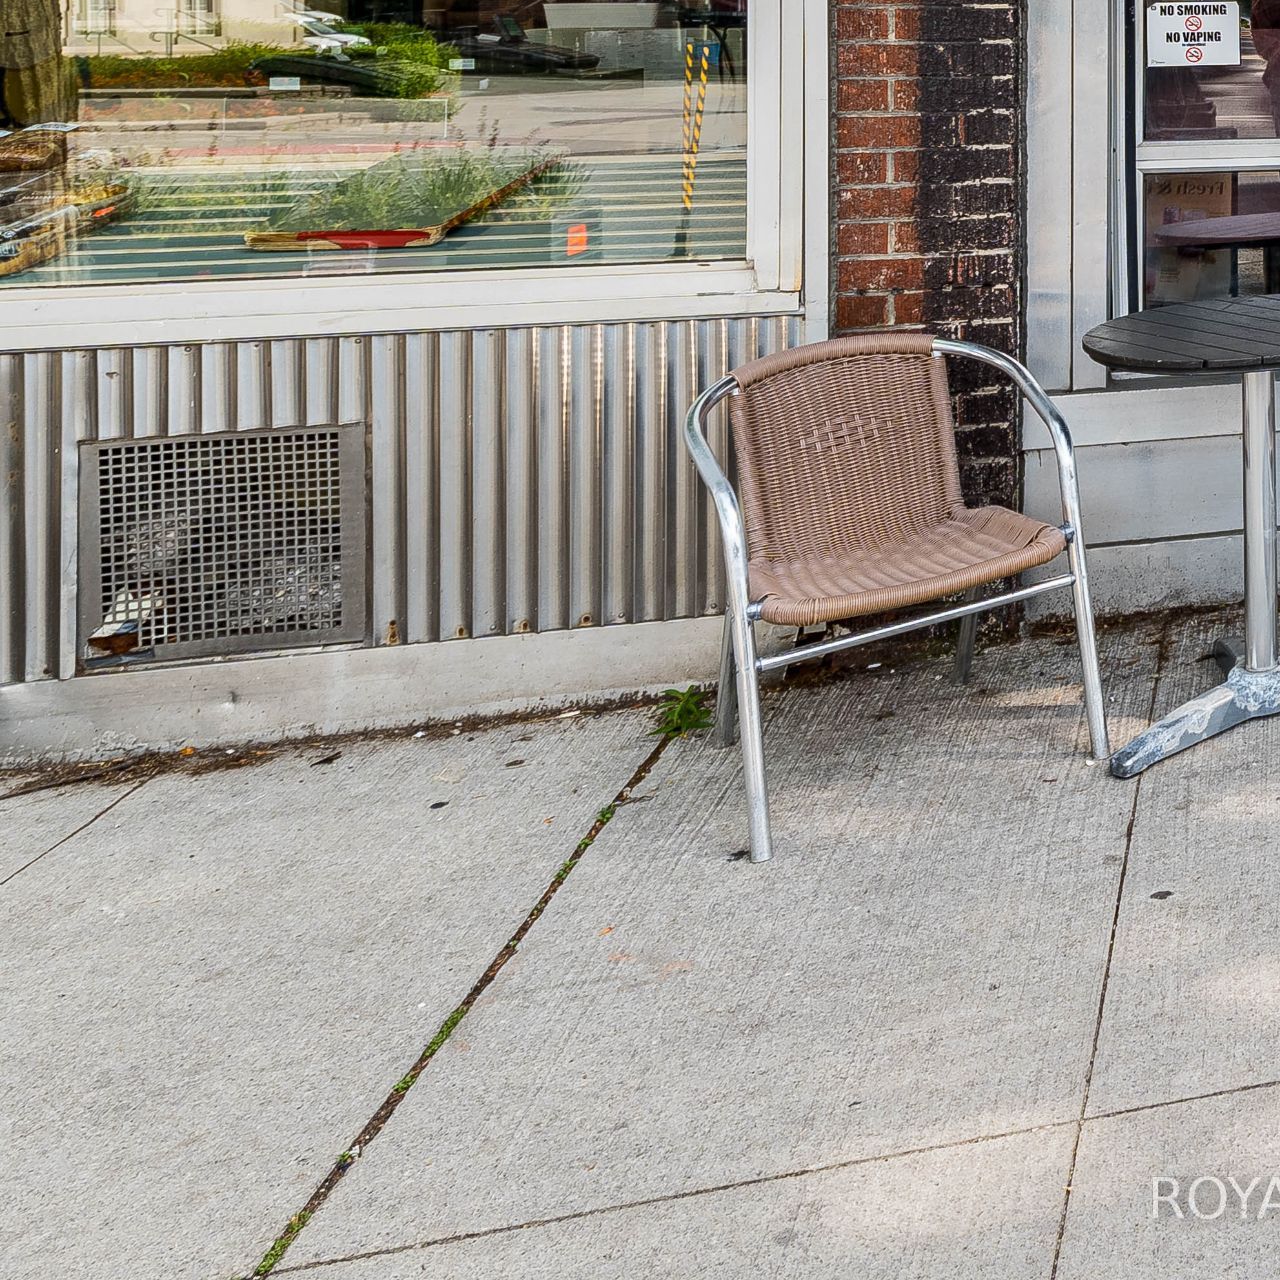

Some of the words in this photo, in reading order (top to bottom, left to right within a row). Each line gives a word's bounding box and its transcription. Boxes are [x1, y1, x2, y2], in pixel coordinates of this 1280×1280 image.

[1160, 5, 1174, 16] NO
[1177, 4, 1227, 16] SMOKING
[1166, 32, 1180, 43] NO
[1183, 31, 1221, 42] VAPING
